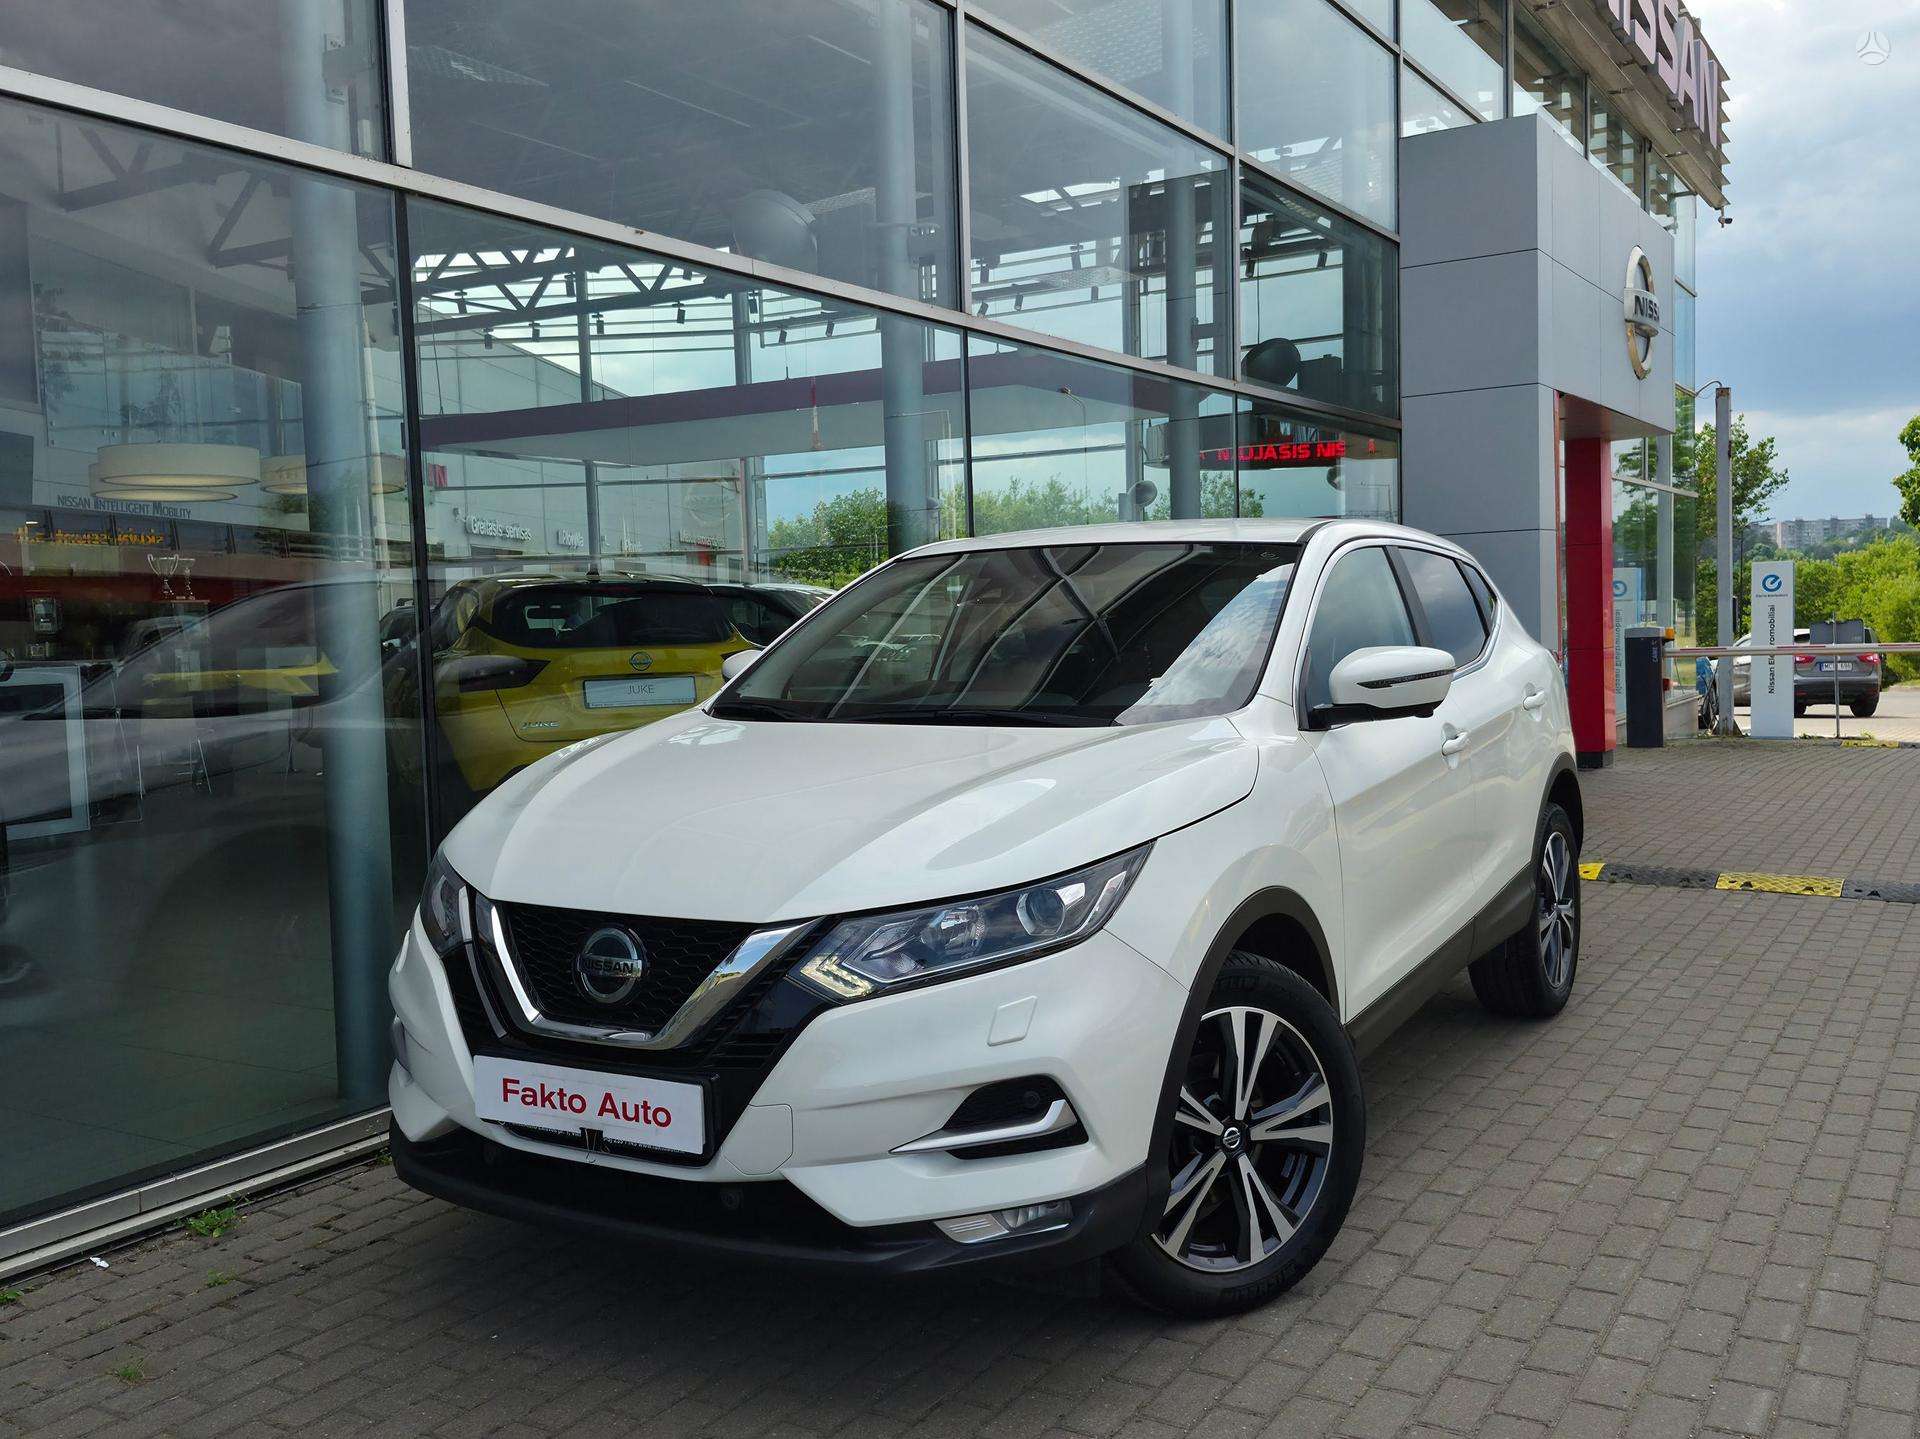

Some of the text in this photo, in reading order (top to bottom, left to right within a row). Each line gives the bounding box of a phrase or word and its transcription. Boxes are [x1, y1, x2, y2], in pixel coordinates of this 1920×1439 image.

[57, 495, 192, 519] NISSAN INTELLIGENT MOBILITY
[627, 684, 655, 695] JUKE
[502, 1077, 672, 1128] Fakto Auto
